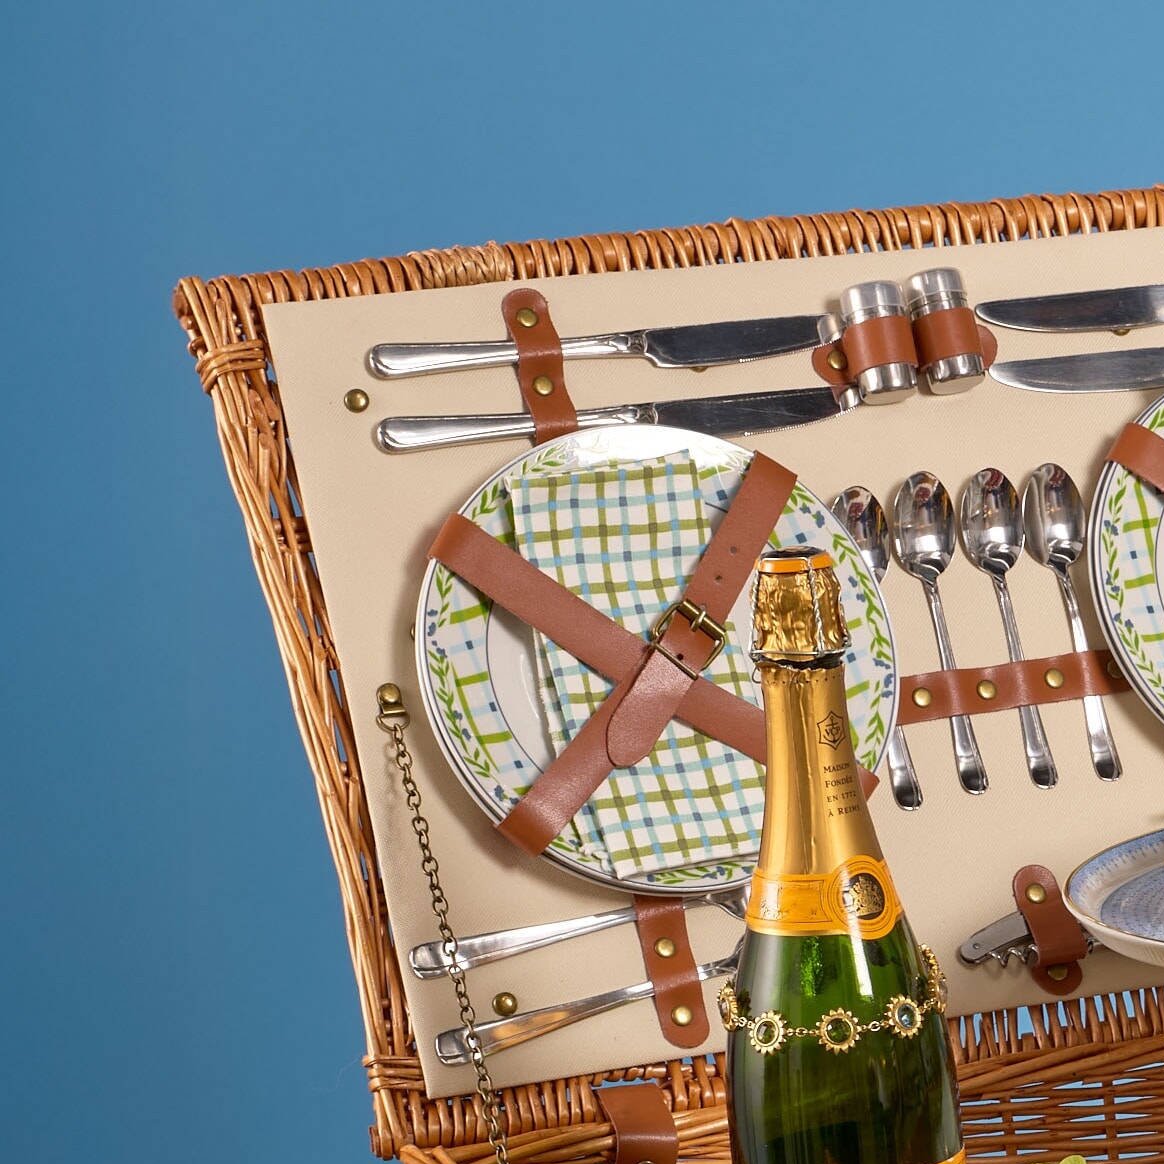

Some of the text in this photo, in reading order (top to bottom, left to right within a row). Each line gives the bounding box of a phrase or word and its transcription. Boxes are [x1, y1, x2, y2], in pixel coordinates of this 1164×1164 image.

[823, 763, 850, 774] MAISON
[841, 790, 857, 800] 1772
[837, 804, 860, 815] REIMS
